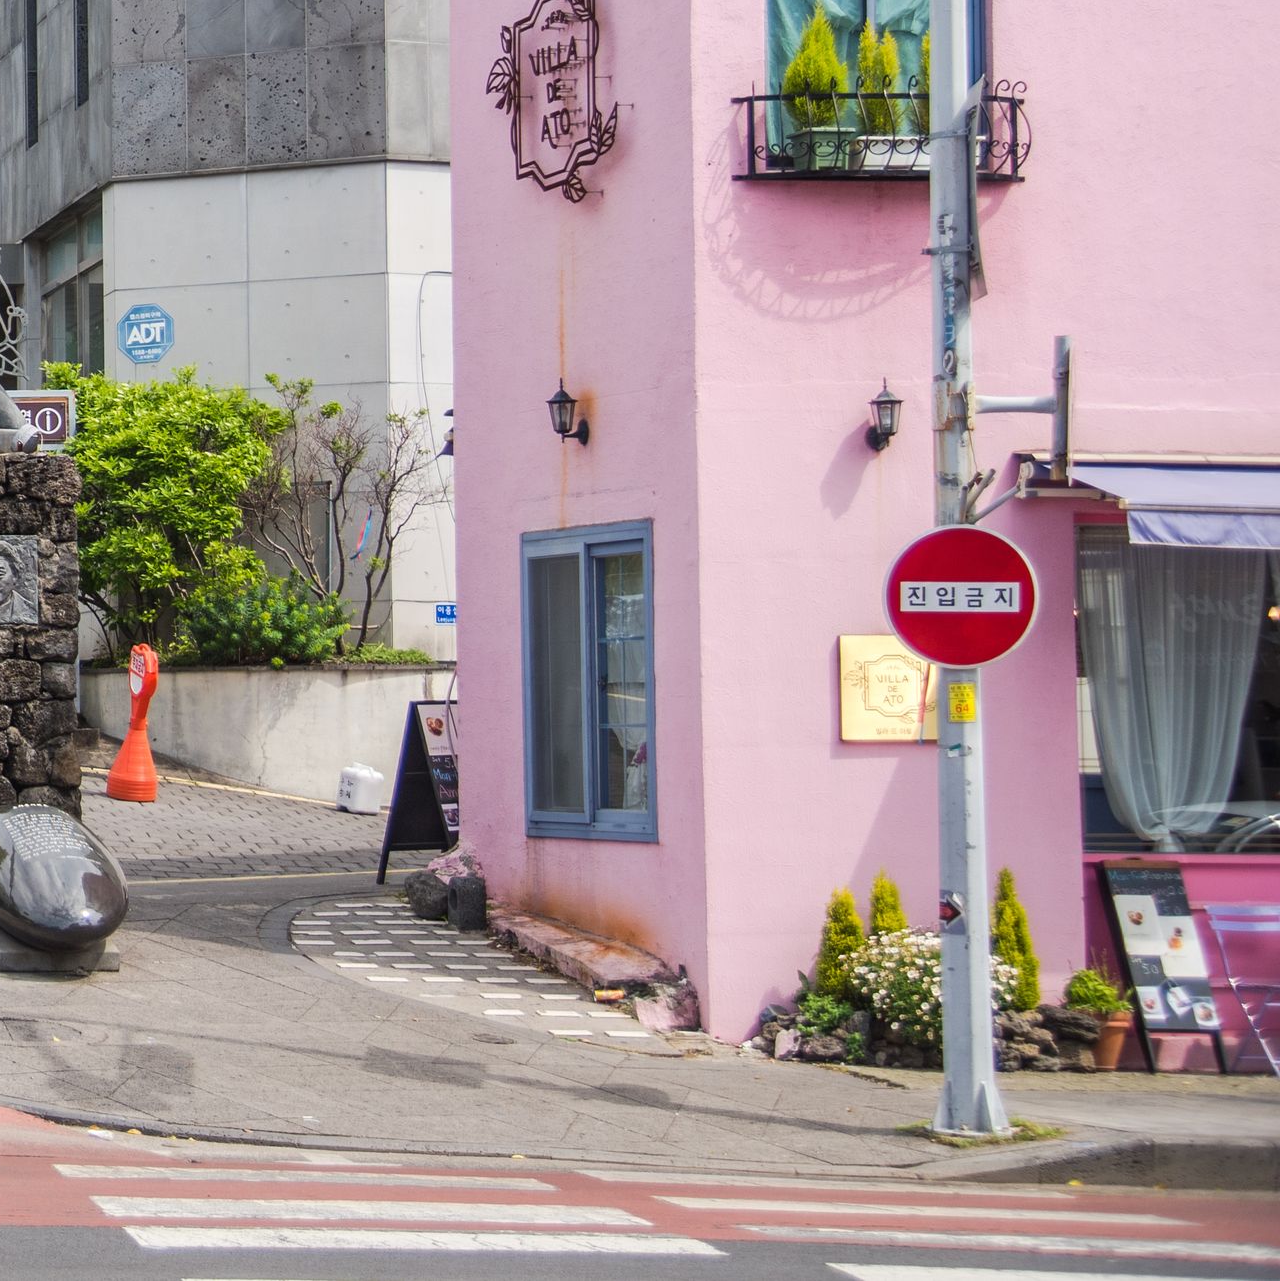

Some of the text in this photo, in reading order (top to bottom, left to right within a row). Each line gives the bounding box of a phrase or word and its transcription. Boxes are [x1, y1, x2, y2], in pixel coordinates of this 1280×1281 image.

[528, 36, 578, 77] VILLA
[546, 78, 562, 104] DE
[541, 107, 572, 149] ATO
[127, 322, 165, 345] ADT
[907, 586, 1013, 608] 진입금지
[875, 674, 909, 684] VILLA
[887, 685, 899, 693] DE
[882, 694, 904, 707] ATO
